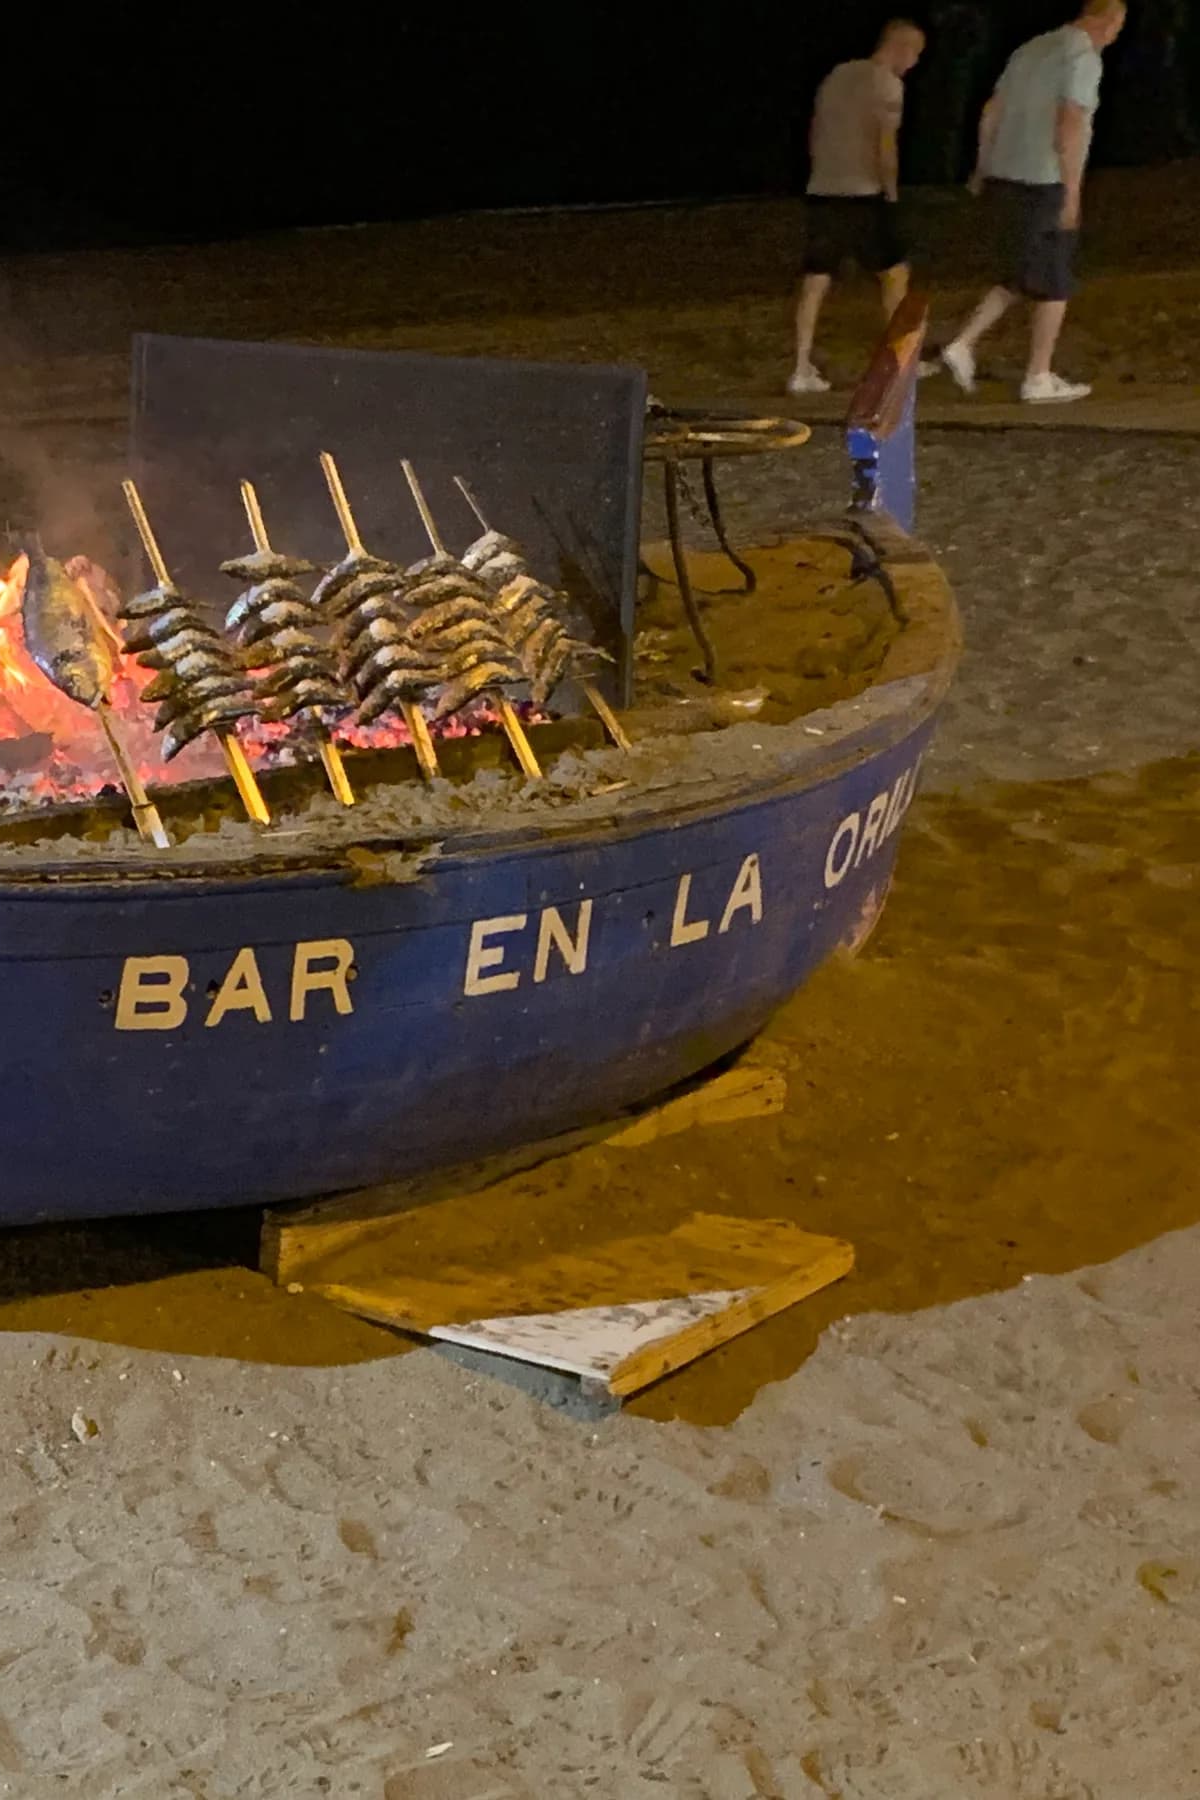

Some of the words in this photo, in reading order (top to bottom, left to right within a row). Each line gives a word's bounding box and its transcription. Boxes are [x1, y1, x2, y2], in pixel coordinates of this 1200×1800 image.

[115, 937, 354, 1030] BAR
[464, 899, 593, 996] EN
[670, 853, 763, 947] LA
